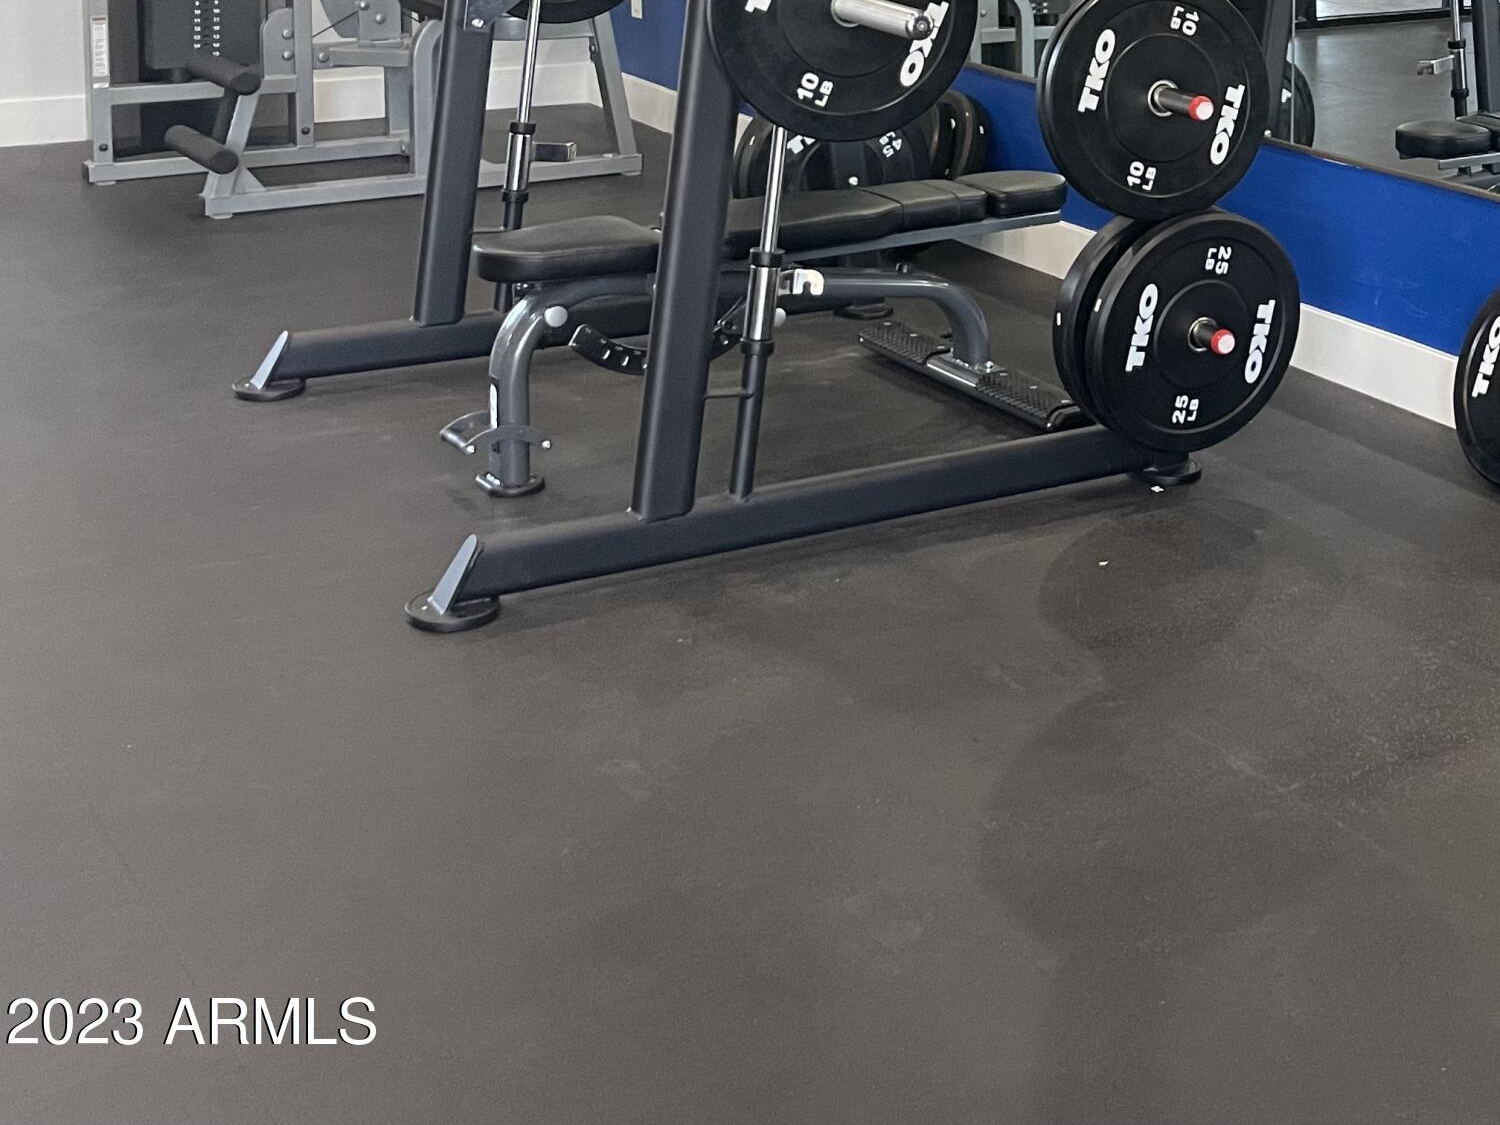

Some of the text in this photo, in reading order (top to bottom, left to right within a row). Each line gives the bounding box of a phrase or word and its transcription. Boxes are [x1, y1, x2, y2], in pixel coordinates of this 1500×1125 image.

[1170, 5, 1185, 31] LB
[1182, 10, 1200, 36] 10
[1078, 28, 1117, 114] TKO
[797, 72, 820, 101] 10
[815, 80, 834, 107] LB
[879, 131, 896, 145] LB
[1209, 84, 1246, 167] TKO
[882, 138, 902, 158] 45
[1127, 161, 1145, 189] 10
[1142, 166, 1157, 192] LB
[1205, 248, 1216, 271] LB
[1215, 245, 1232, 275] 25
[1125, 283, 1159, 373] TKO
[1244, 298, 1277, 384] TKO
[1172, 394, 1189, 424] 25
[1187, 397, 1199, 422] LB
